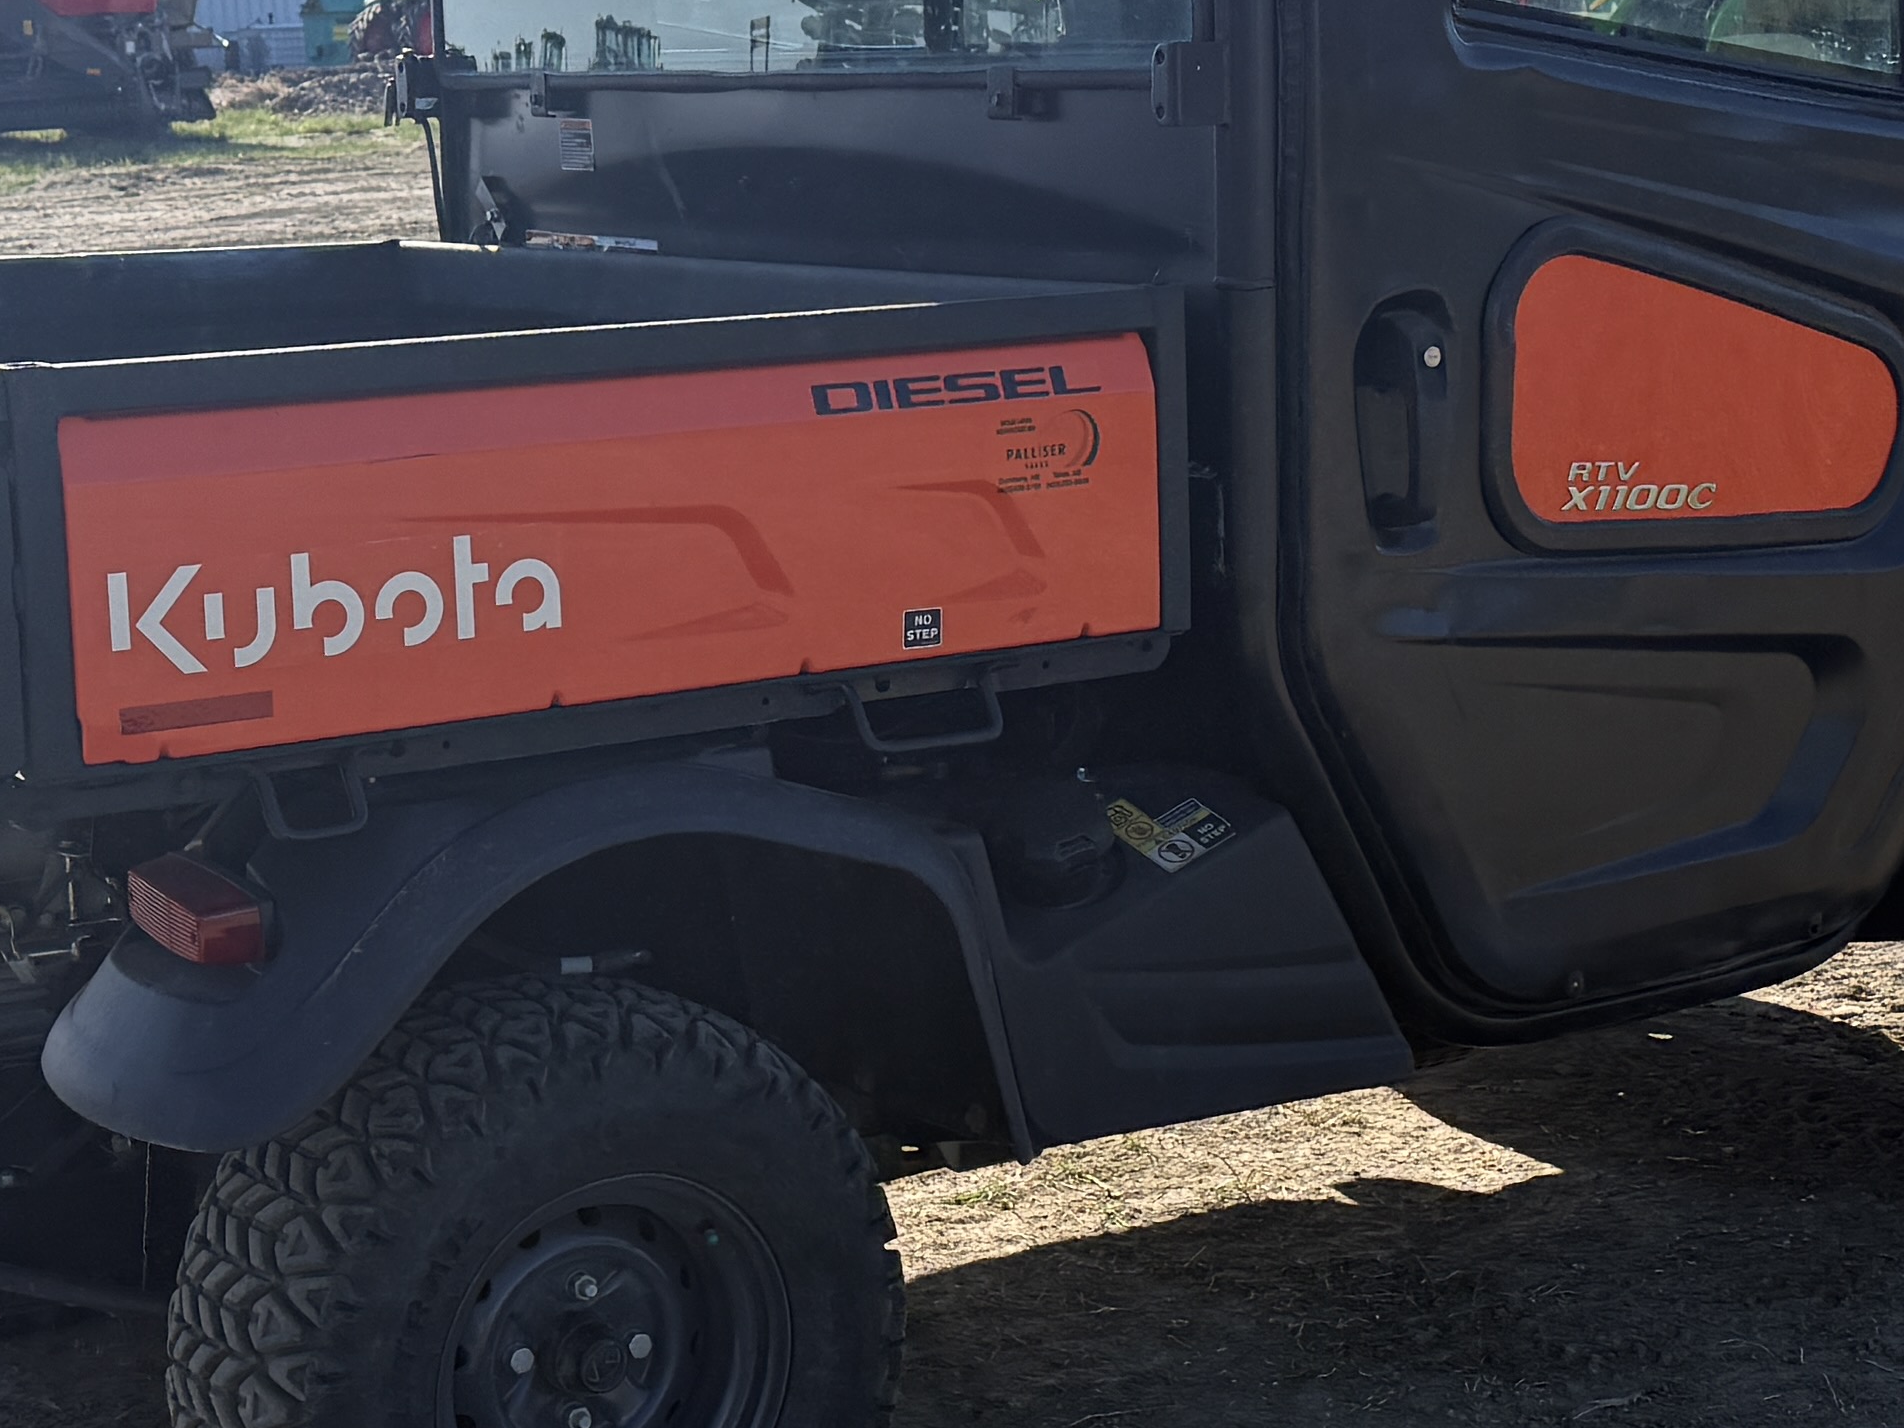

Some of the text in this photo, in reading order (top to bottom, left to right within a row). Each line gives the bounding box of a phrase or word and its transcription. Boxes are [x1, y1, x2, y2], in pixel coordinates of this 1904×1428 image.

[810, 365, 1102, 416] DIESEL
[1007, 443, 1067, 461] PALLISER
[1568, 461, 1640, 482] RTV
[1560, 483, 1717, 511] X1100C
[107, 534, 563, 675] Kubota
[914, 614, 932, 627] NO
[906, 627, 939, 641] STEP
[1197, 823, 1215, 834] NO
[1199, 824, 1226, 844] STEP
